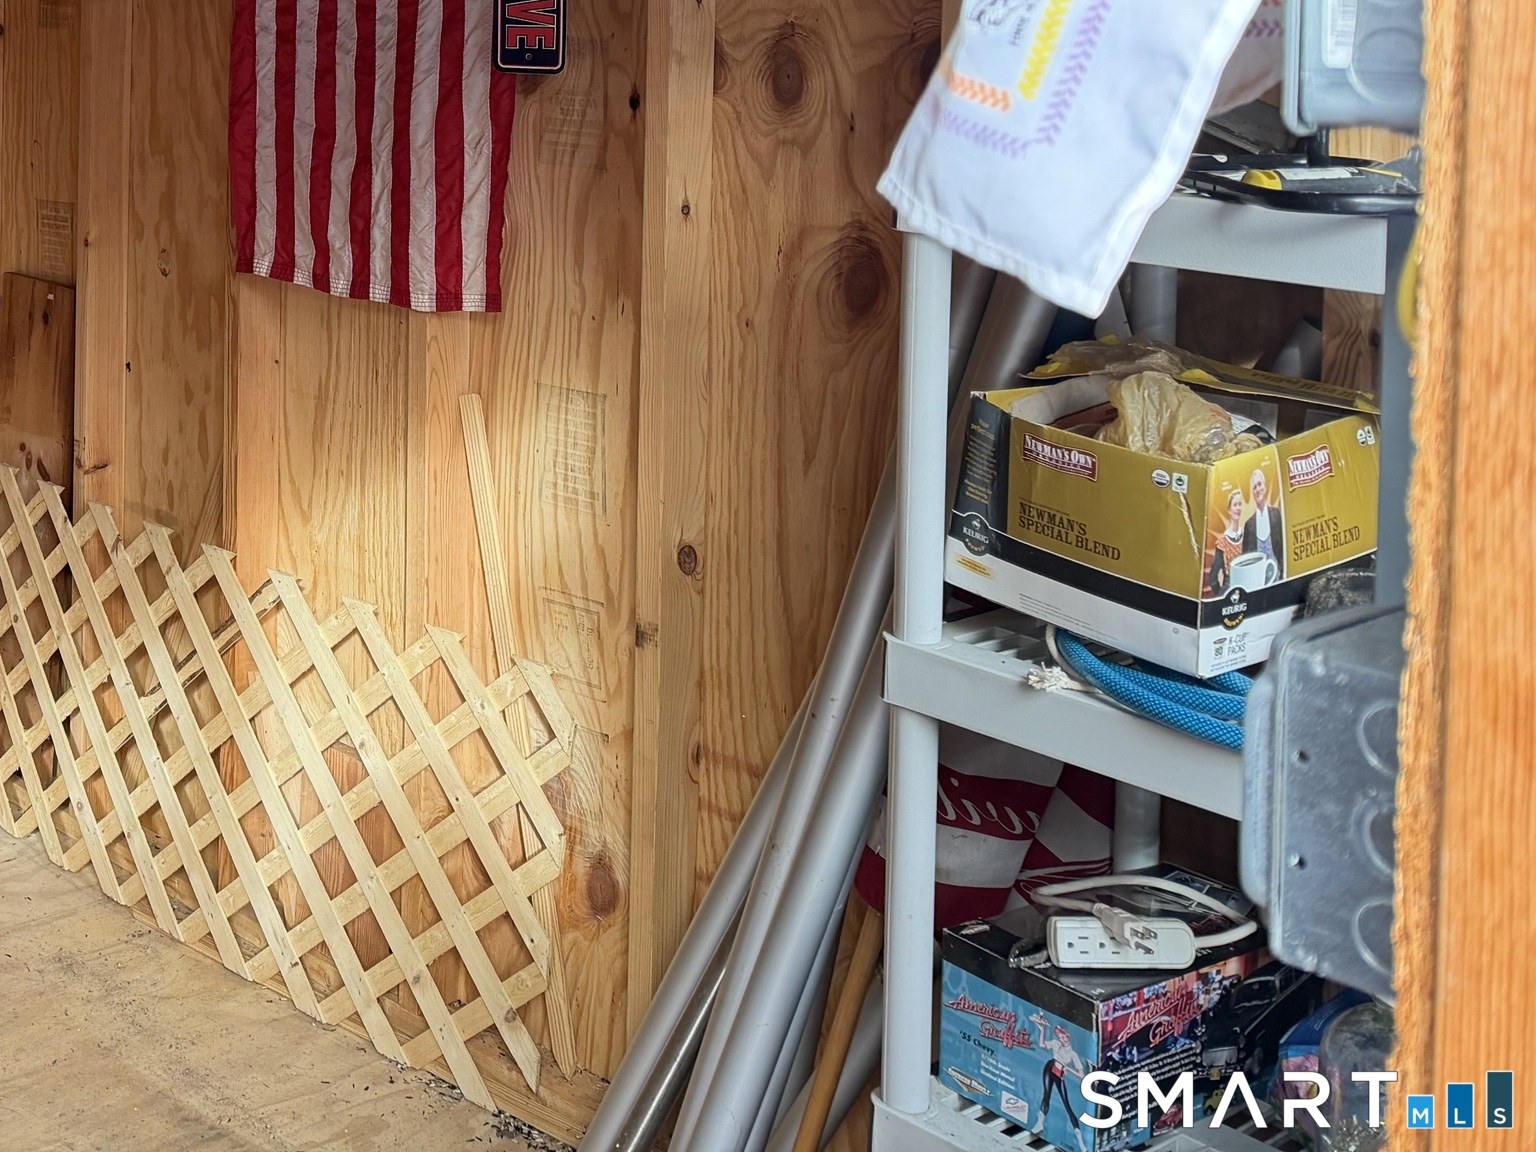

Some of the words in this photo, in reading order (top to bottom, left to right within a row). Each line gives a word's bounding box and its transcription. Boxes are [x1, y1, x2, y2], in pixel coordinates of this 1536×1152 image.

[1024, 433, 1070, 462] NEWMAN'S
[1070, 449, 1094, 469] OWN
[962, 526, 990, 545] KEURIG
[1019, 501, 1087, 537] NEWMAN'S
[1292, 516, 1339, 546] NEWMAN'S
[1018, 515, 1073, 546] SPECIAL
[1074, 534, 1121, 561] BLEND
[1293, 534, 1332, 562] SPECIAL
[1332, 525, 1361, 549] BLEND
[1221, 603, 1248, 616] KEURIG
[944, 993, 1017, 1023] American
